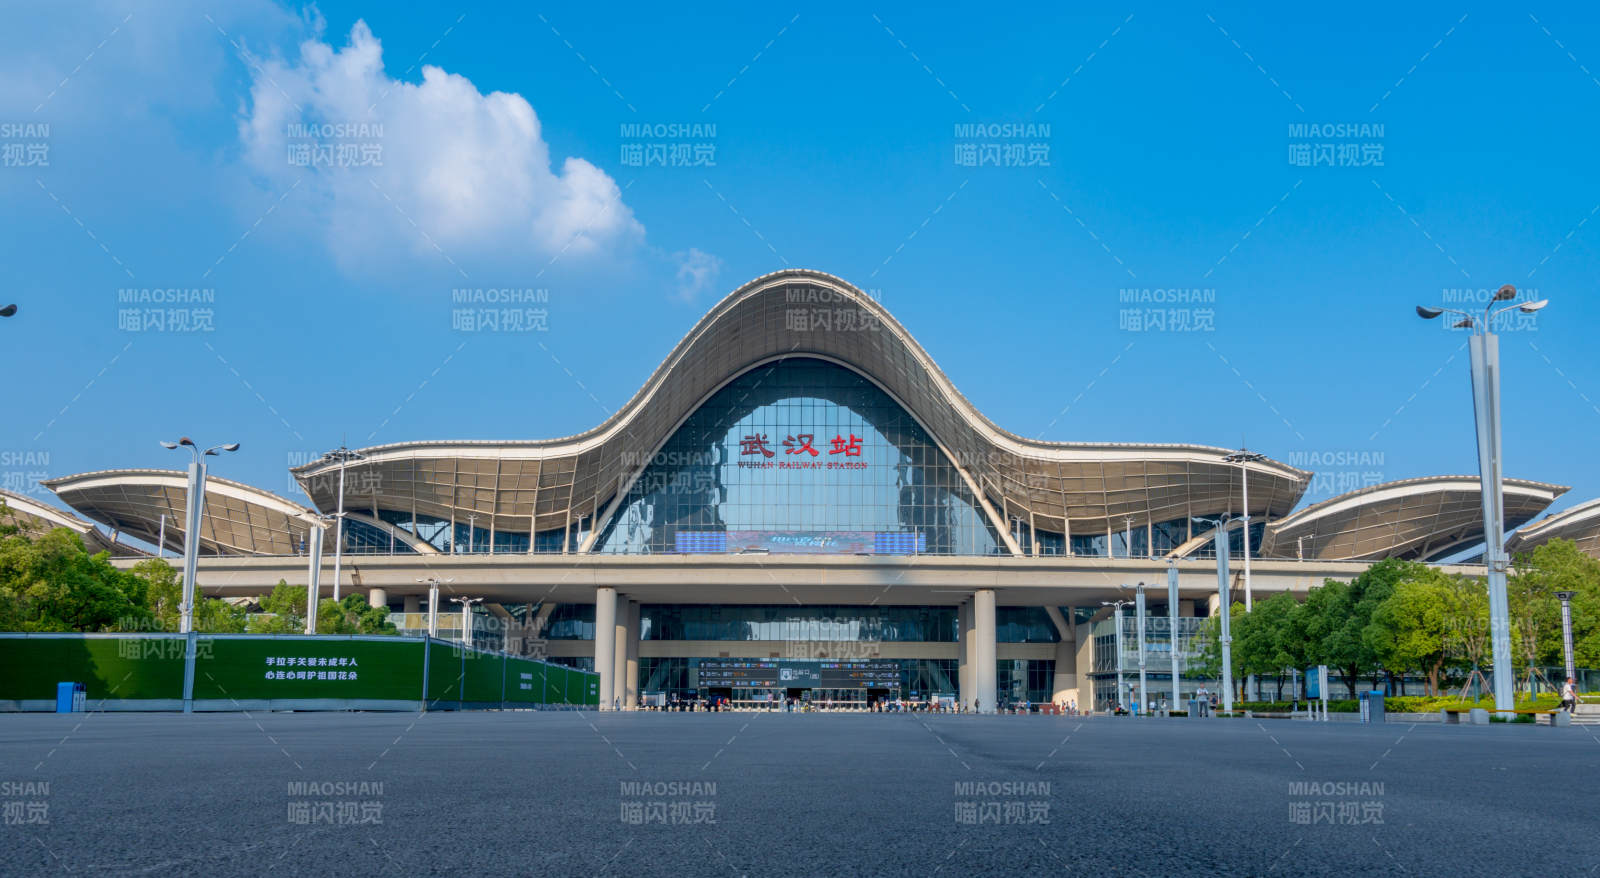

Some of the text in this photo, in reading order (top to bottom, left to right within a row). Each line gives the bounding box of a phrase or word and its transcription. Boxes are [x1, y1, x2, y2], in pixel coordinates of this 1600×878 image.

[740, 433, 863, 458] 武汉站
[738, 461, 868, 469] WUHAN RAILWAY STATION
[265, 657, 358, 667] 手拉手关爱未成年人
[265, 670, 358, 680] 心连心呵护祖国花朵
